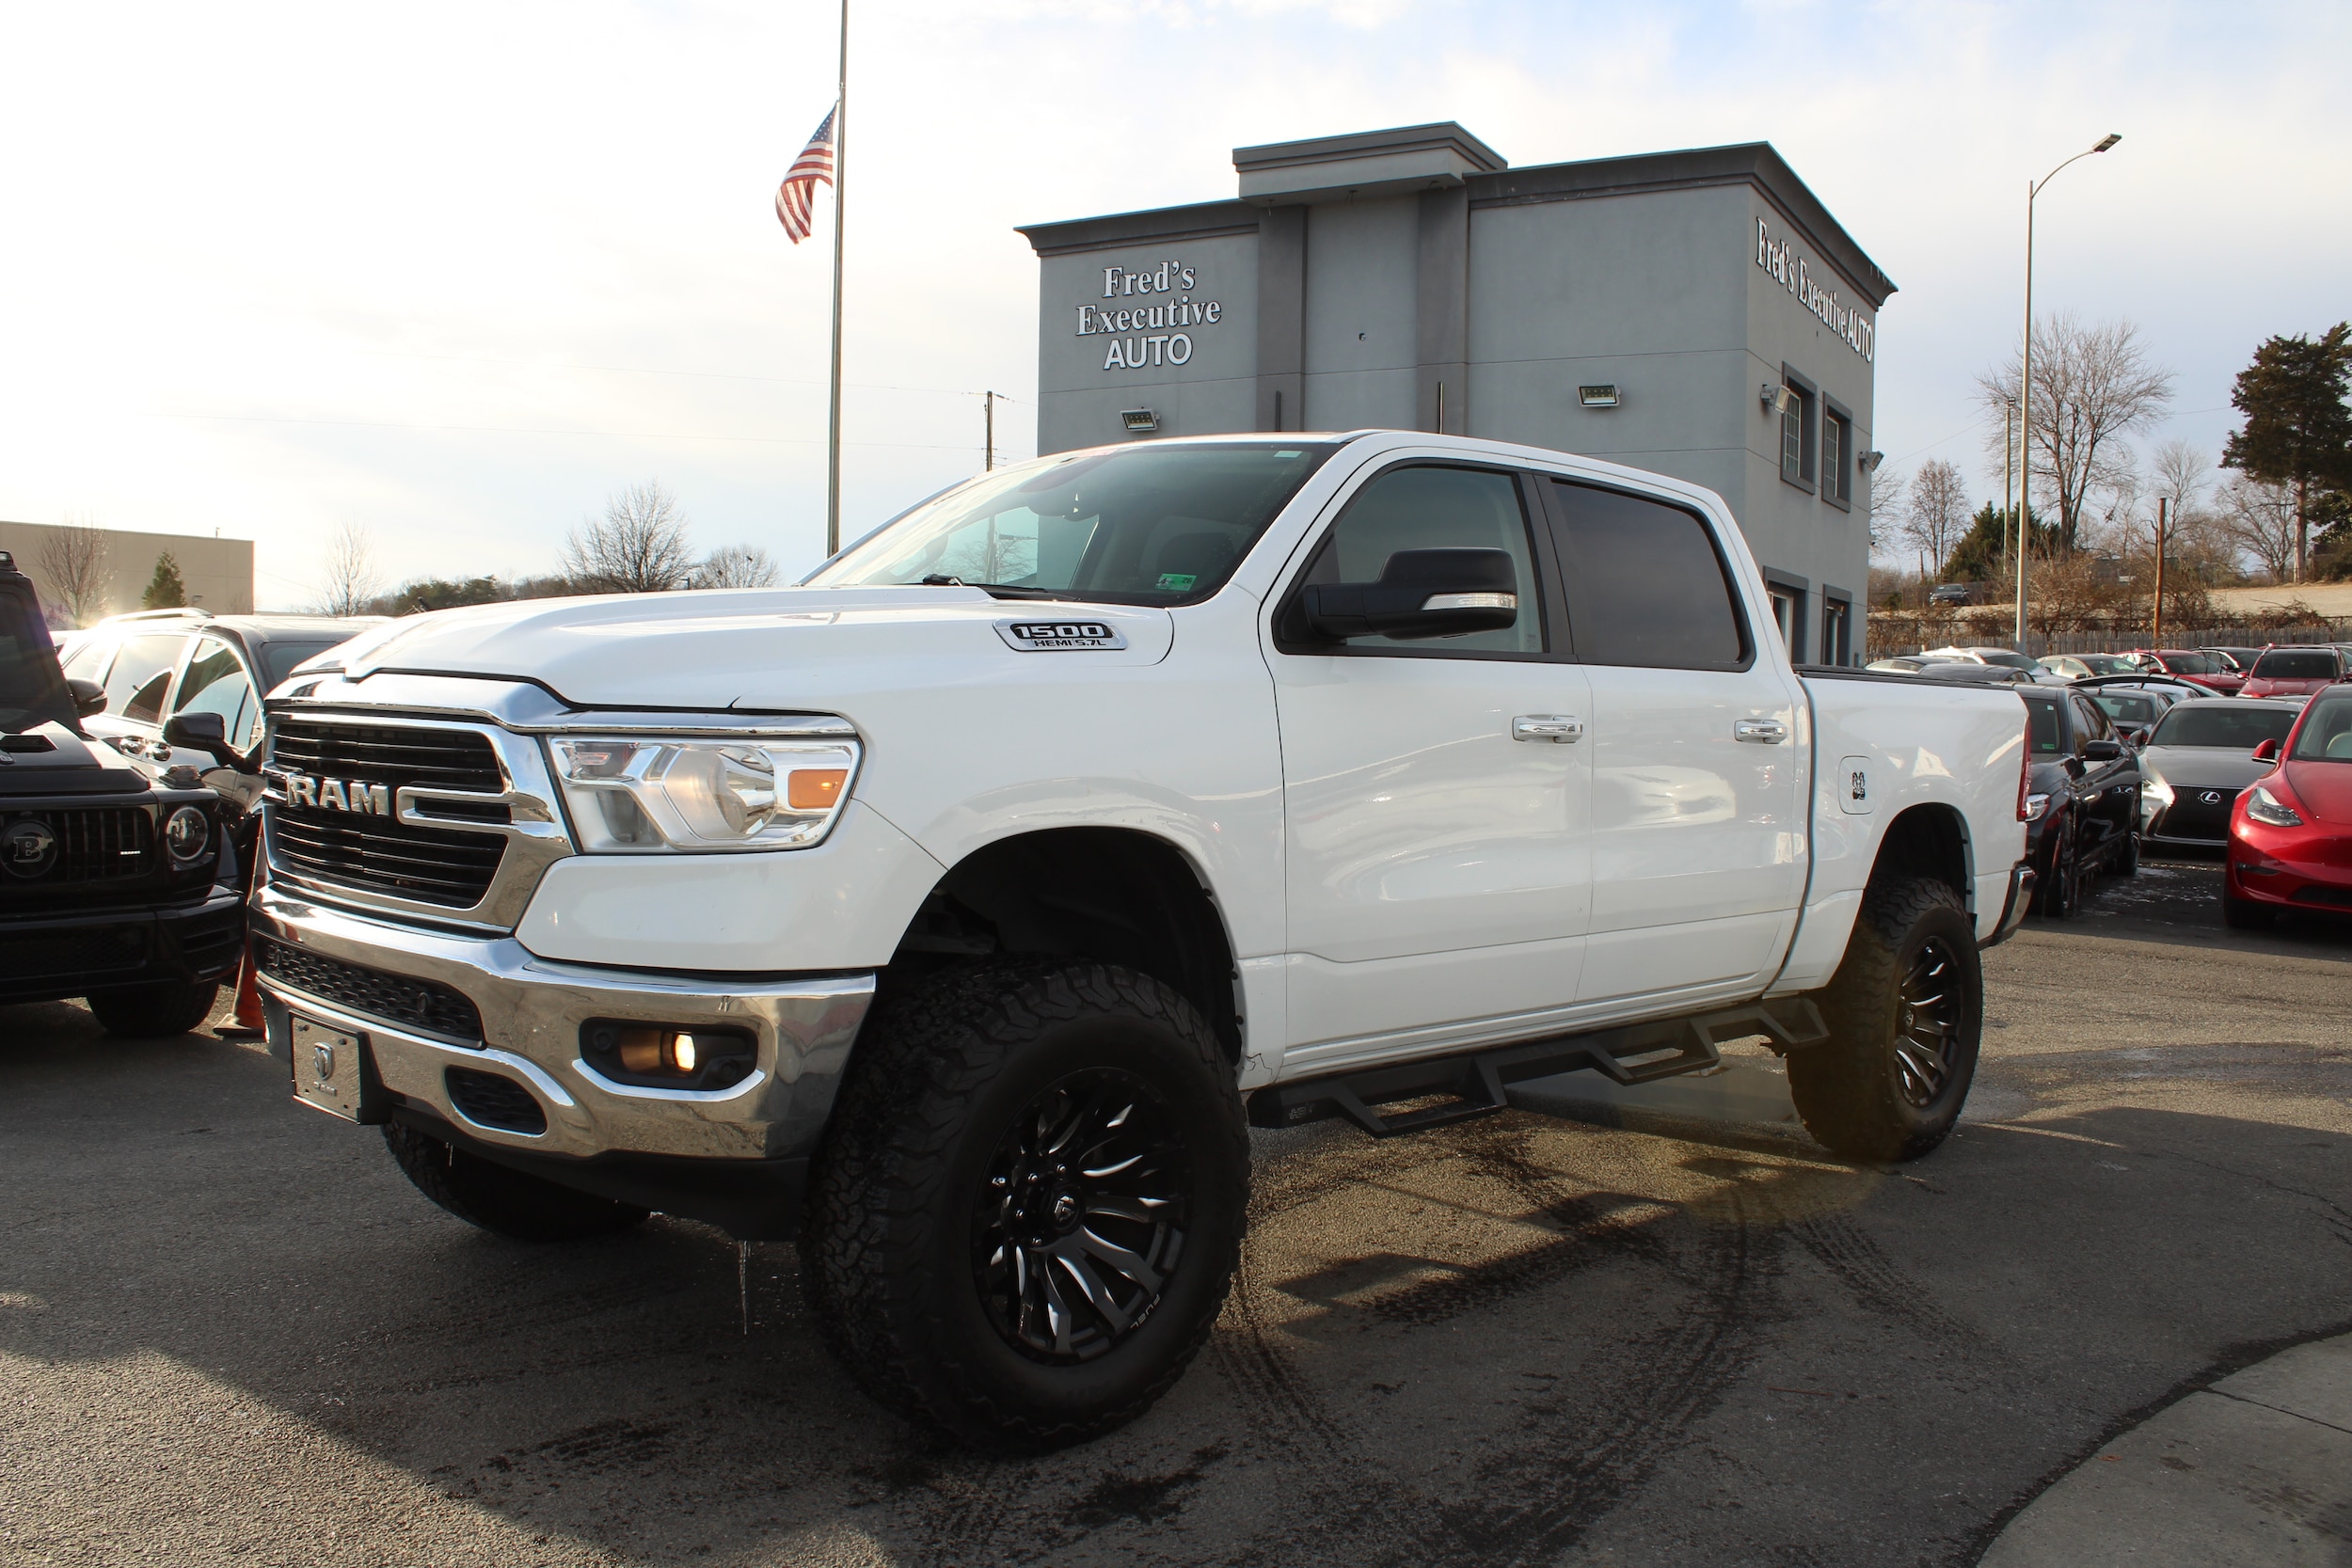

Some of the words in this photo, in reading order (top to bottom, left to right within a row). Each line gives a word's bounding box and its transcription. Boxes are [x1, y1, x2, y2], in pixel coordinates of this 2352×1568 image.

[1102, 261, 1196, 297] Fred's
[1756, 216, 1795, 293] Fred's
[1798, 257, 1848, 339] Executive
[1847, 307, 1874, 363] AUTO
[1075, 295, 1221, 336] Executive
[1103, 333, 1193, 370] AUTO
[1014, 625, 1105, 638] 1500
[1034, 639, 1072, 647] HEMI
[286, 774, 390, 816] RAM
[13, 836, 44, 863] B
[1129, 1293, 1161, 1329] FUEL
